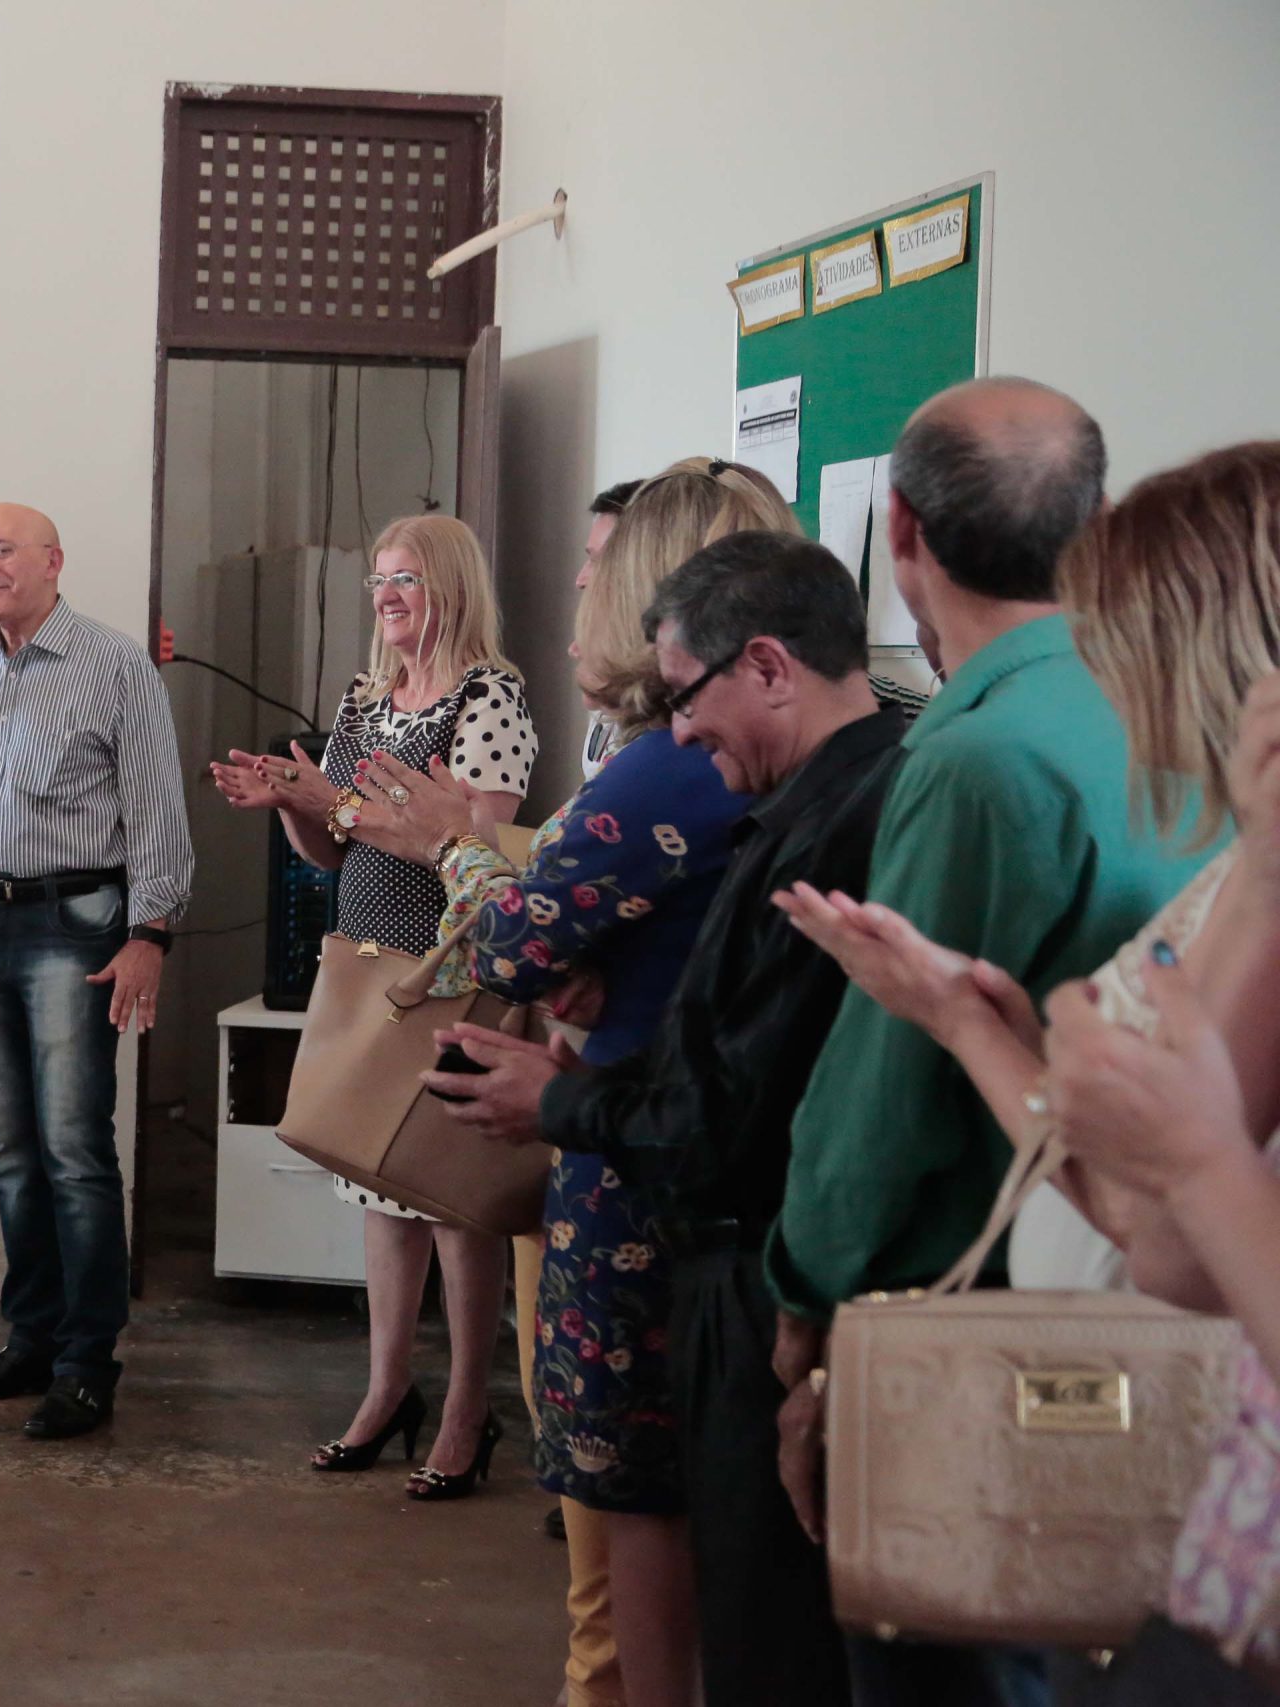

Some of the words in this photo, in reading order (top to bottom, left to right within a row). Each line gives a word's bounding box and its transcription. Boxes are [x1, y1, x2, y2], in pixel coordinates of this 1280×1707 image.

[739, 275, 799, 305] CRONOGRAMA
[817, 253, 876, 288] ATIVIDADES
[898, 213, 960, 253] EXTERNAS
